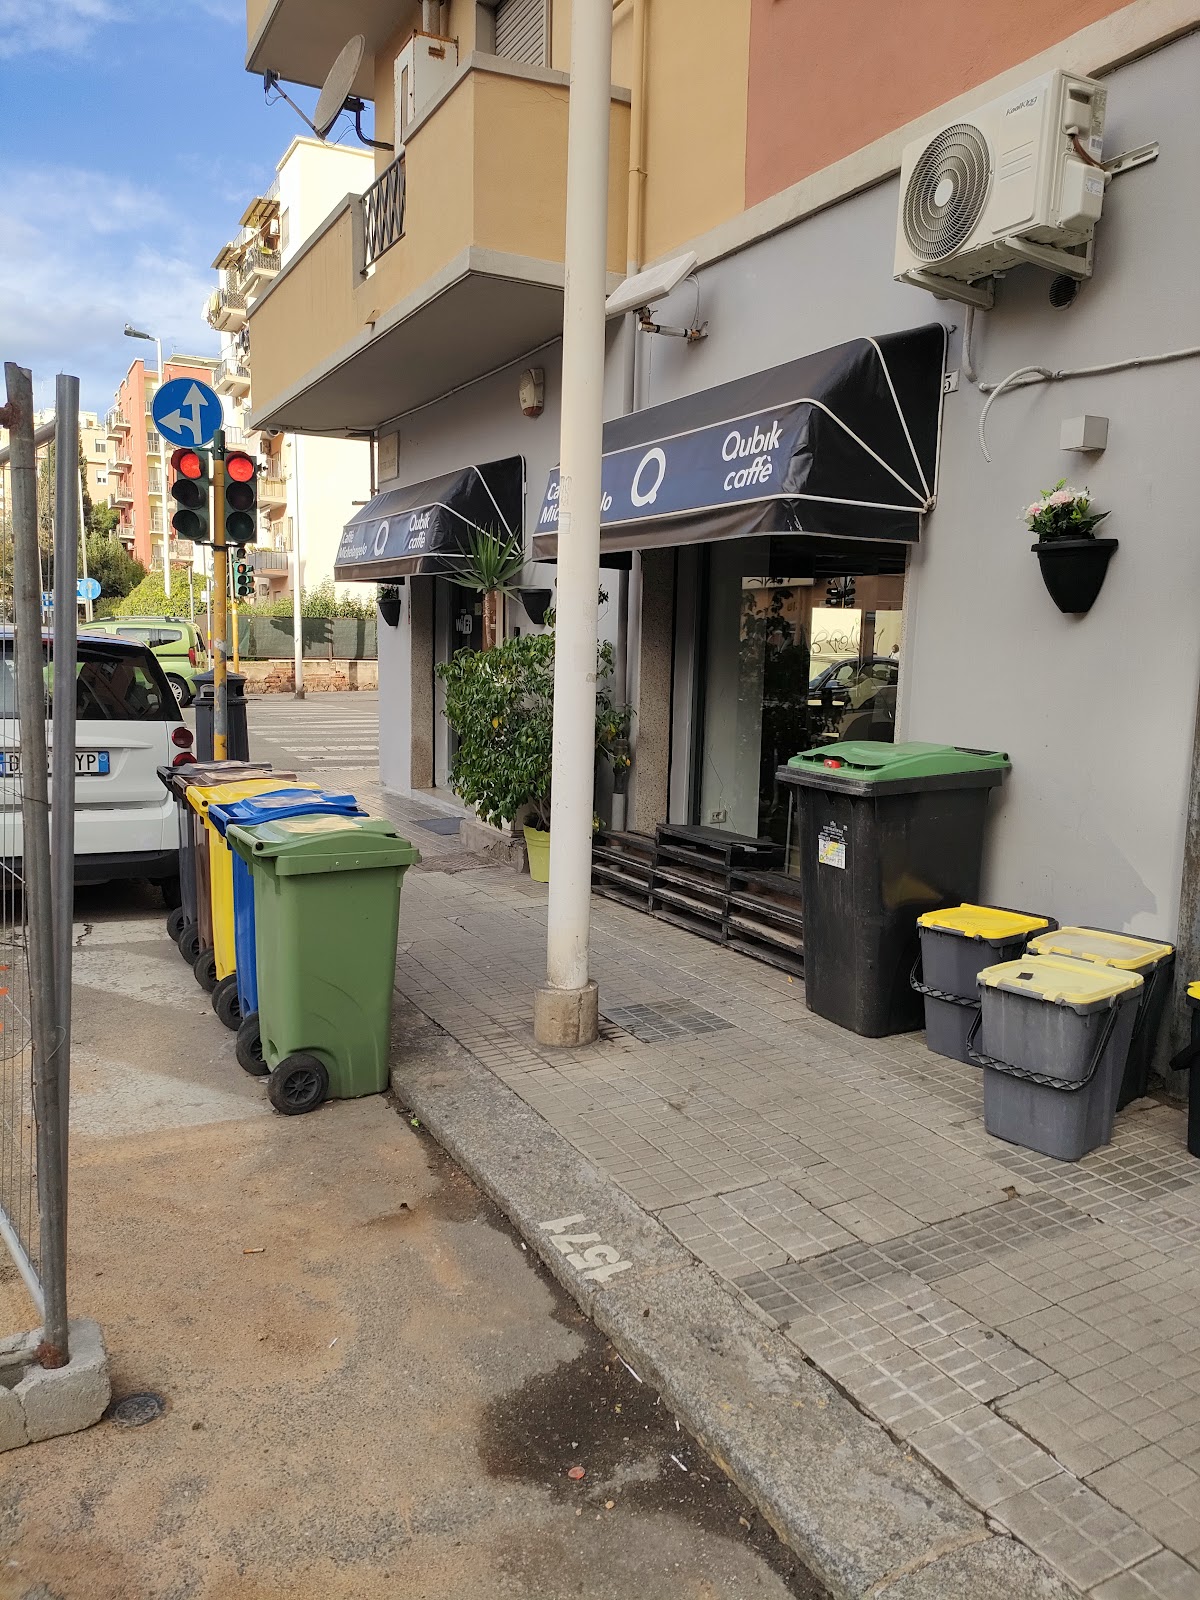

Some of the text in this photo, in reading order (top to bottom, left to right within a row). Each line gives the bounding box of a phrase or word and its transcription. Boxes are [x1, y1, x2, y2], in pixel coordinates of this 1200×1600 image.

[721, 420, 784, 462] Qubik
[723, 454, 773, 491] caffè
[408, 531, 426, 550] caffè
[409, 512, 431, 532] Qubik
[537, 1213, 633, 1283] 1571
